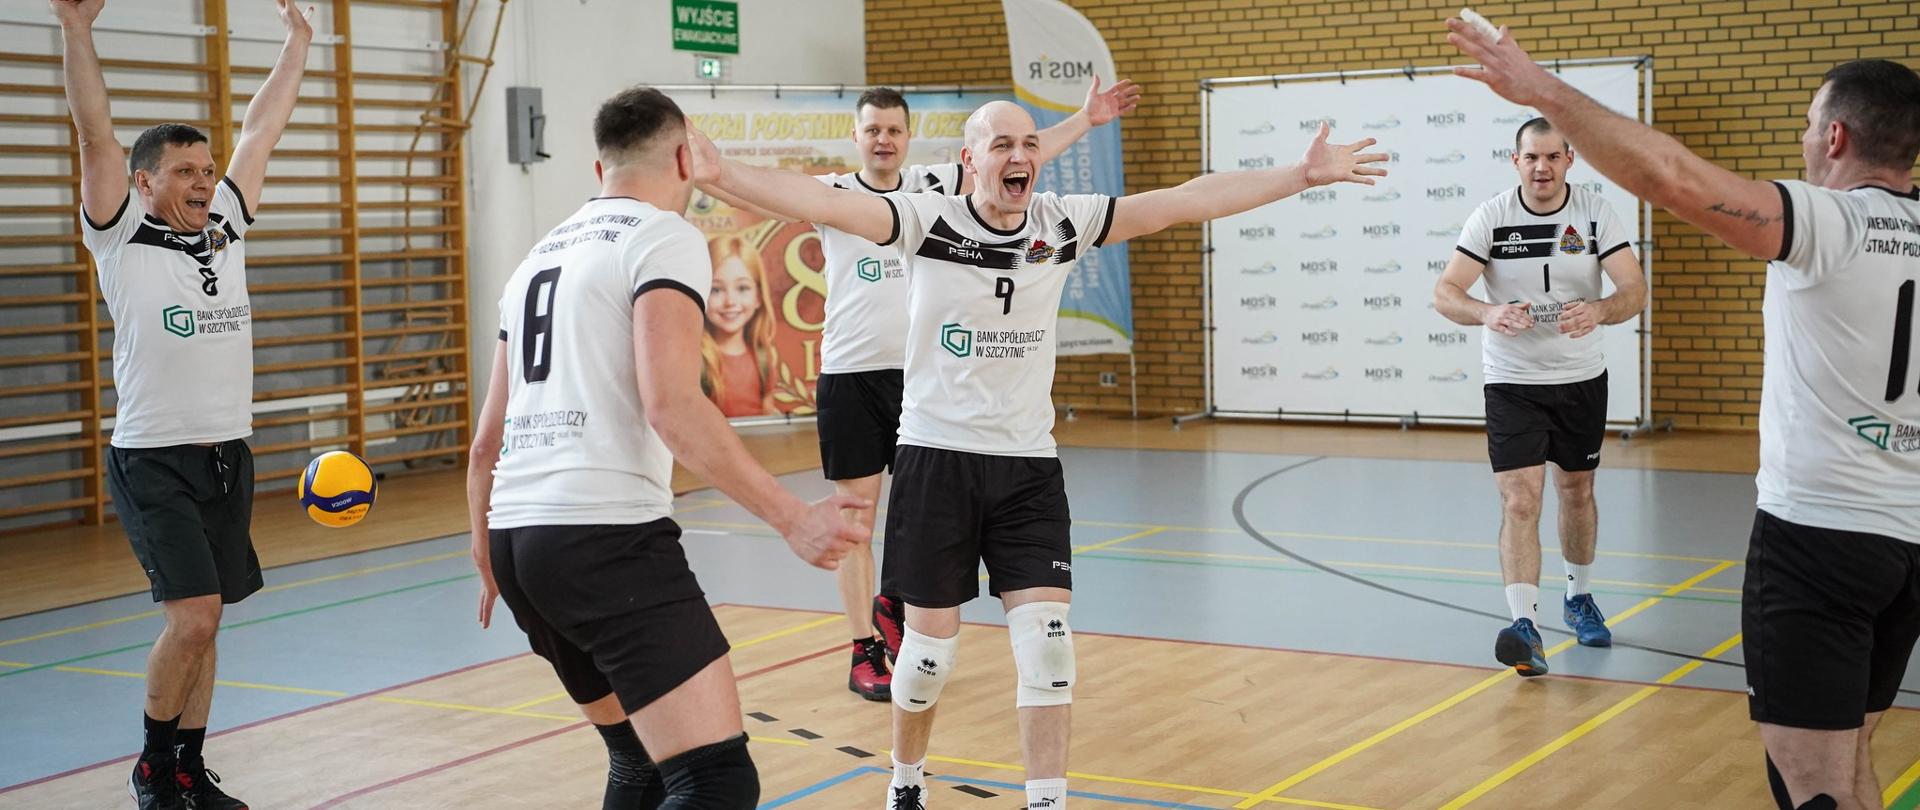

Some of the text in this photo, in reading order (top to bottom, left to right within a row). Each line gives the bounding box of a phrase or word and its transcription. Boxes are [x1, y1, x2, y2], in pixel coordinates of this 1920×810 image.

[676, 4, 735, 28] WYJŚCIE
[675, 28, 737, 46] EWAKUACYJNE
[750, 111, 855, 141] PODSTAW
[1867, 216, 1900, 231] MENDA
[948, 246, 984, 261] PEHA
[1501, 245, 1529, 254] PEHA
[1865, 237, 1901, 256] STRAŻY
[892, 269, 904, 279] SZC
[1543, 263, 1550, 293] 1
[994, 276, 1015, 315] 9
[197, 309, 217, 321] BANK
[199, 324, 207, 335] W
[207, 321, 241, 334] SZCZYTNIE
[522, 265, 562, 385] 8
[977, 330, 999, 344] BANK
[975, 346, 985, 358] W
[985, 346, 1026, 359] SZCZYTNIE
[1052, 560, 1073, 572] PEH
